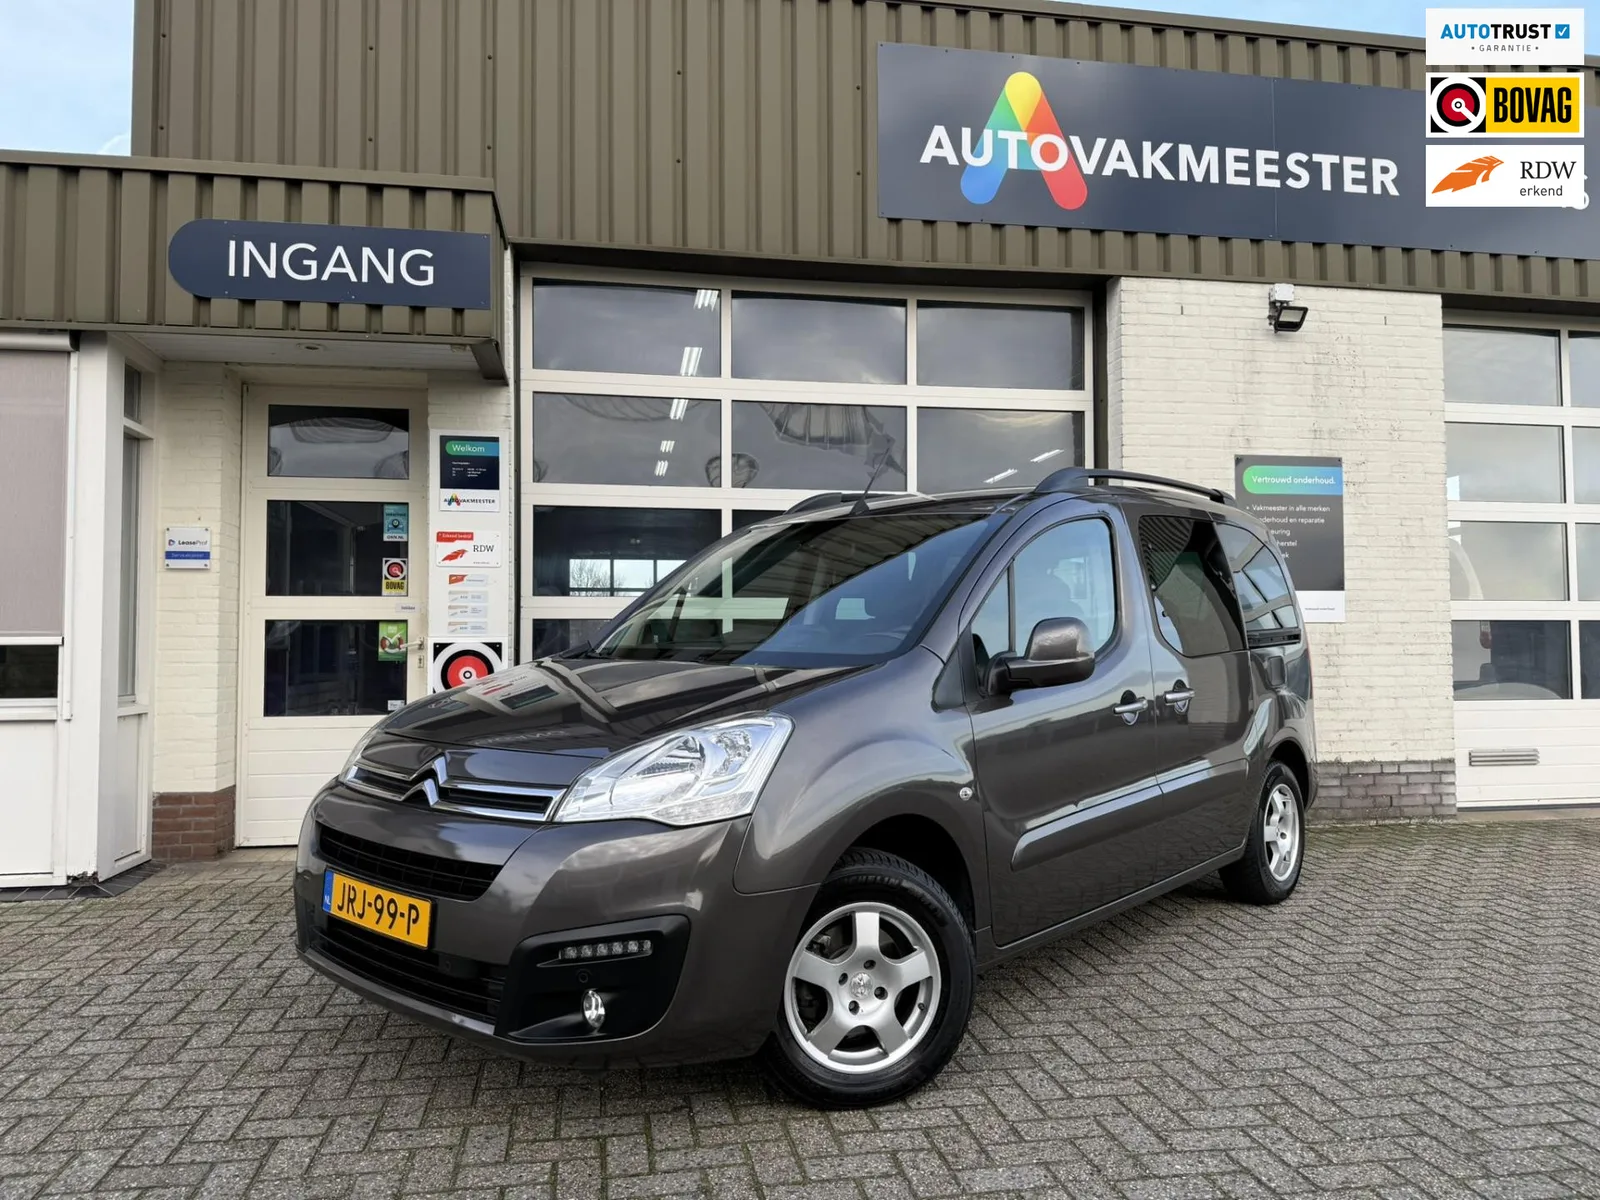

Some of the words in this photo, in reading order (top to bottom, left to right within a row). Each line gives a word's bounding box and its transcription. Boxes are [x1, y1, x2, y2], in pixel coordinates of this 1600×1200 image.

[919, 124, 1400, 197] AUTOVAKMEESTER
[228, 239, 434, 287] INGANG
[452, 444, 485, 452] Welkom
[1252, 476, 1292, 484] Vertrouwd
[1293, 476, 1336, 484] onderhoud.
[1252, 504, 1288, 512] Vakmeester
[1298, 517, 1325, 525] reparatie
[473, 544, 494, 552] RDW
[386, 581, 404, 590] BOVAG
[337, 882, 420, 936] JRJ-99-P
